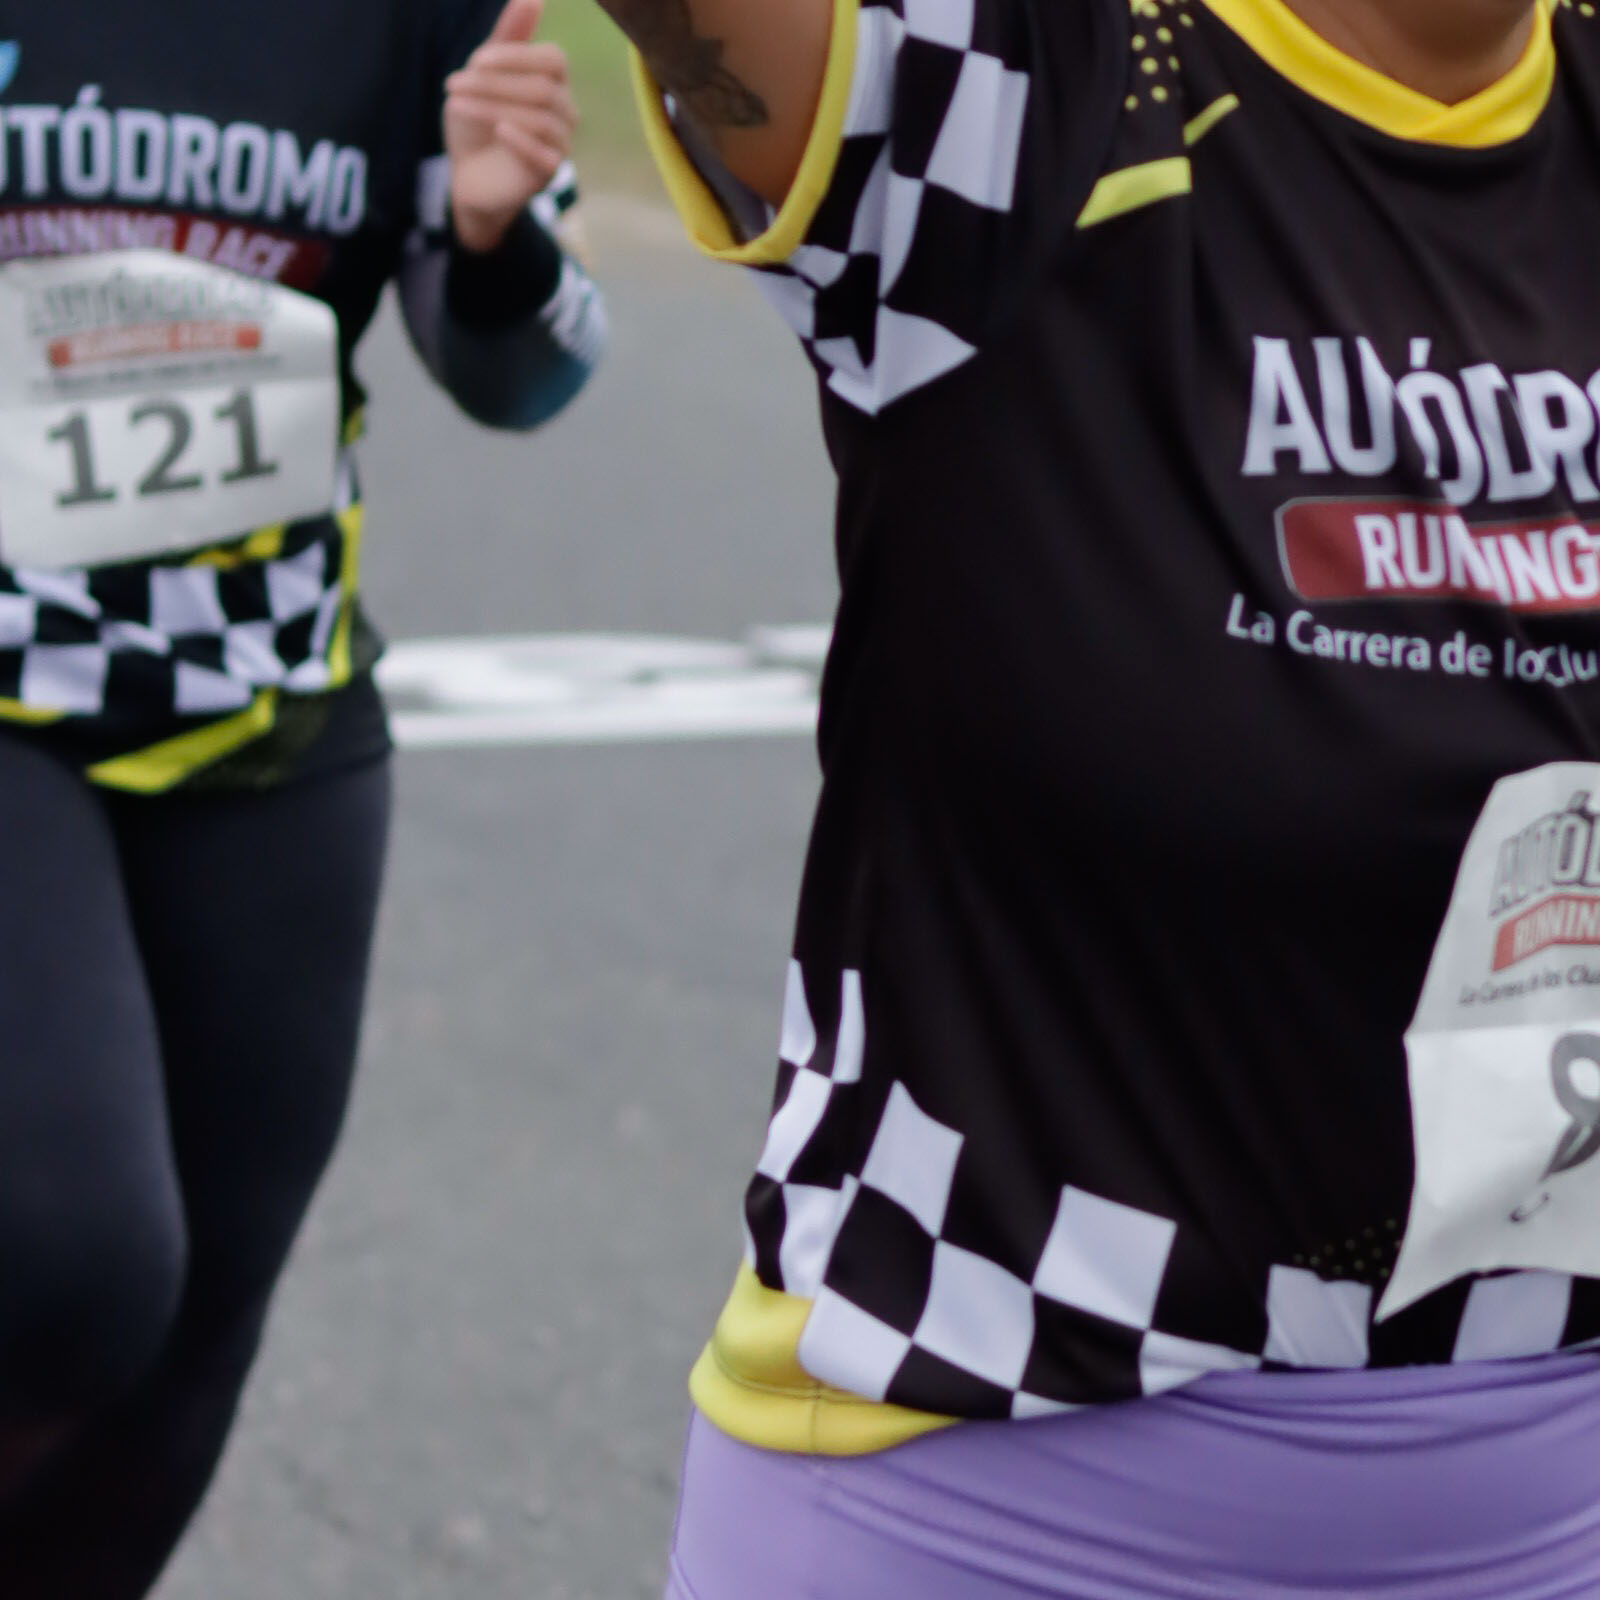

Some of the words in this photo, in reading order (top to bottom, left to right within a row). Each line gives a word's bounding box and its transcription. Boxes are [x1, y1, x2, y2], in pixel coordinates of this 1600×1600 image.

[0, 83, 368, 237] TÓDROMO
[46, 385, 278, 508] 121
[1226, 592, 1275, 645] La
[1286, 609, 1431, 671] Carrera
[1439, 630, 1493, 678] de
